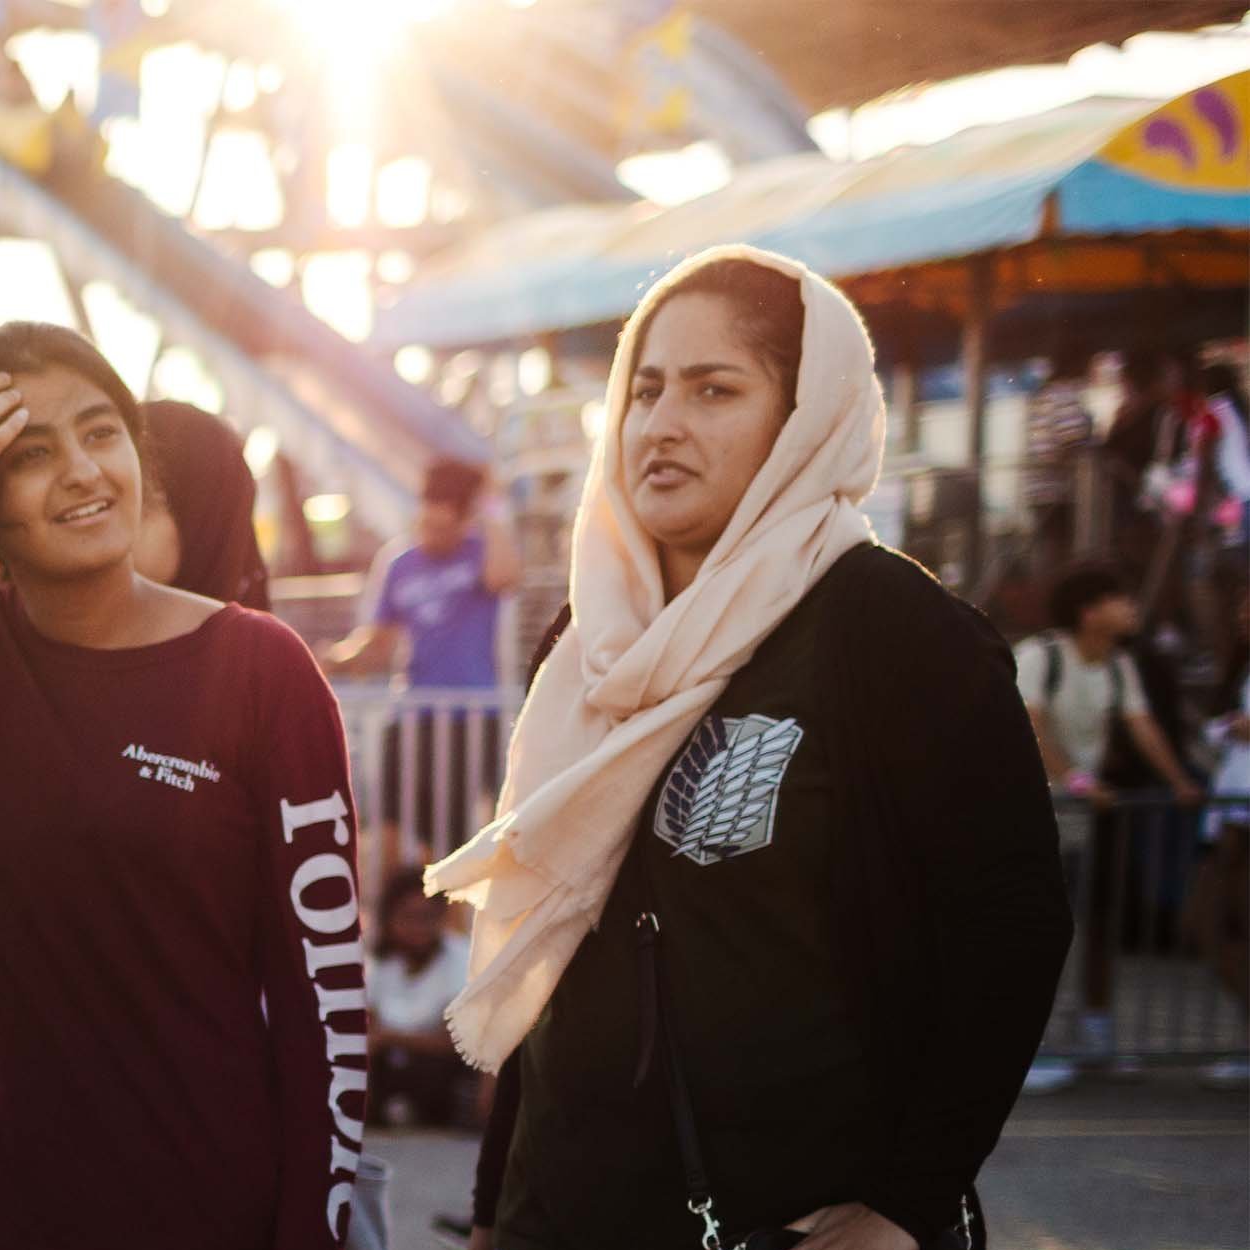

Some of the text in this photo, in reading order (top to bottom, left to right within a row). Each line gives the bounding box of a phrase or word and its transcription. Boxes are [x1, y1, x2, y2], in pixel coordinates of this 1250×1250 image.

[121, 744, 221, 782] Abercrombie
[138, 765, 195, 792] & Fitch
